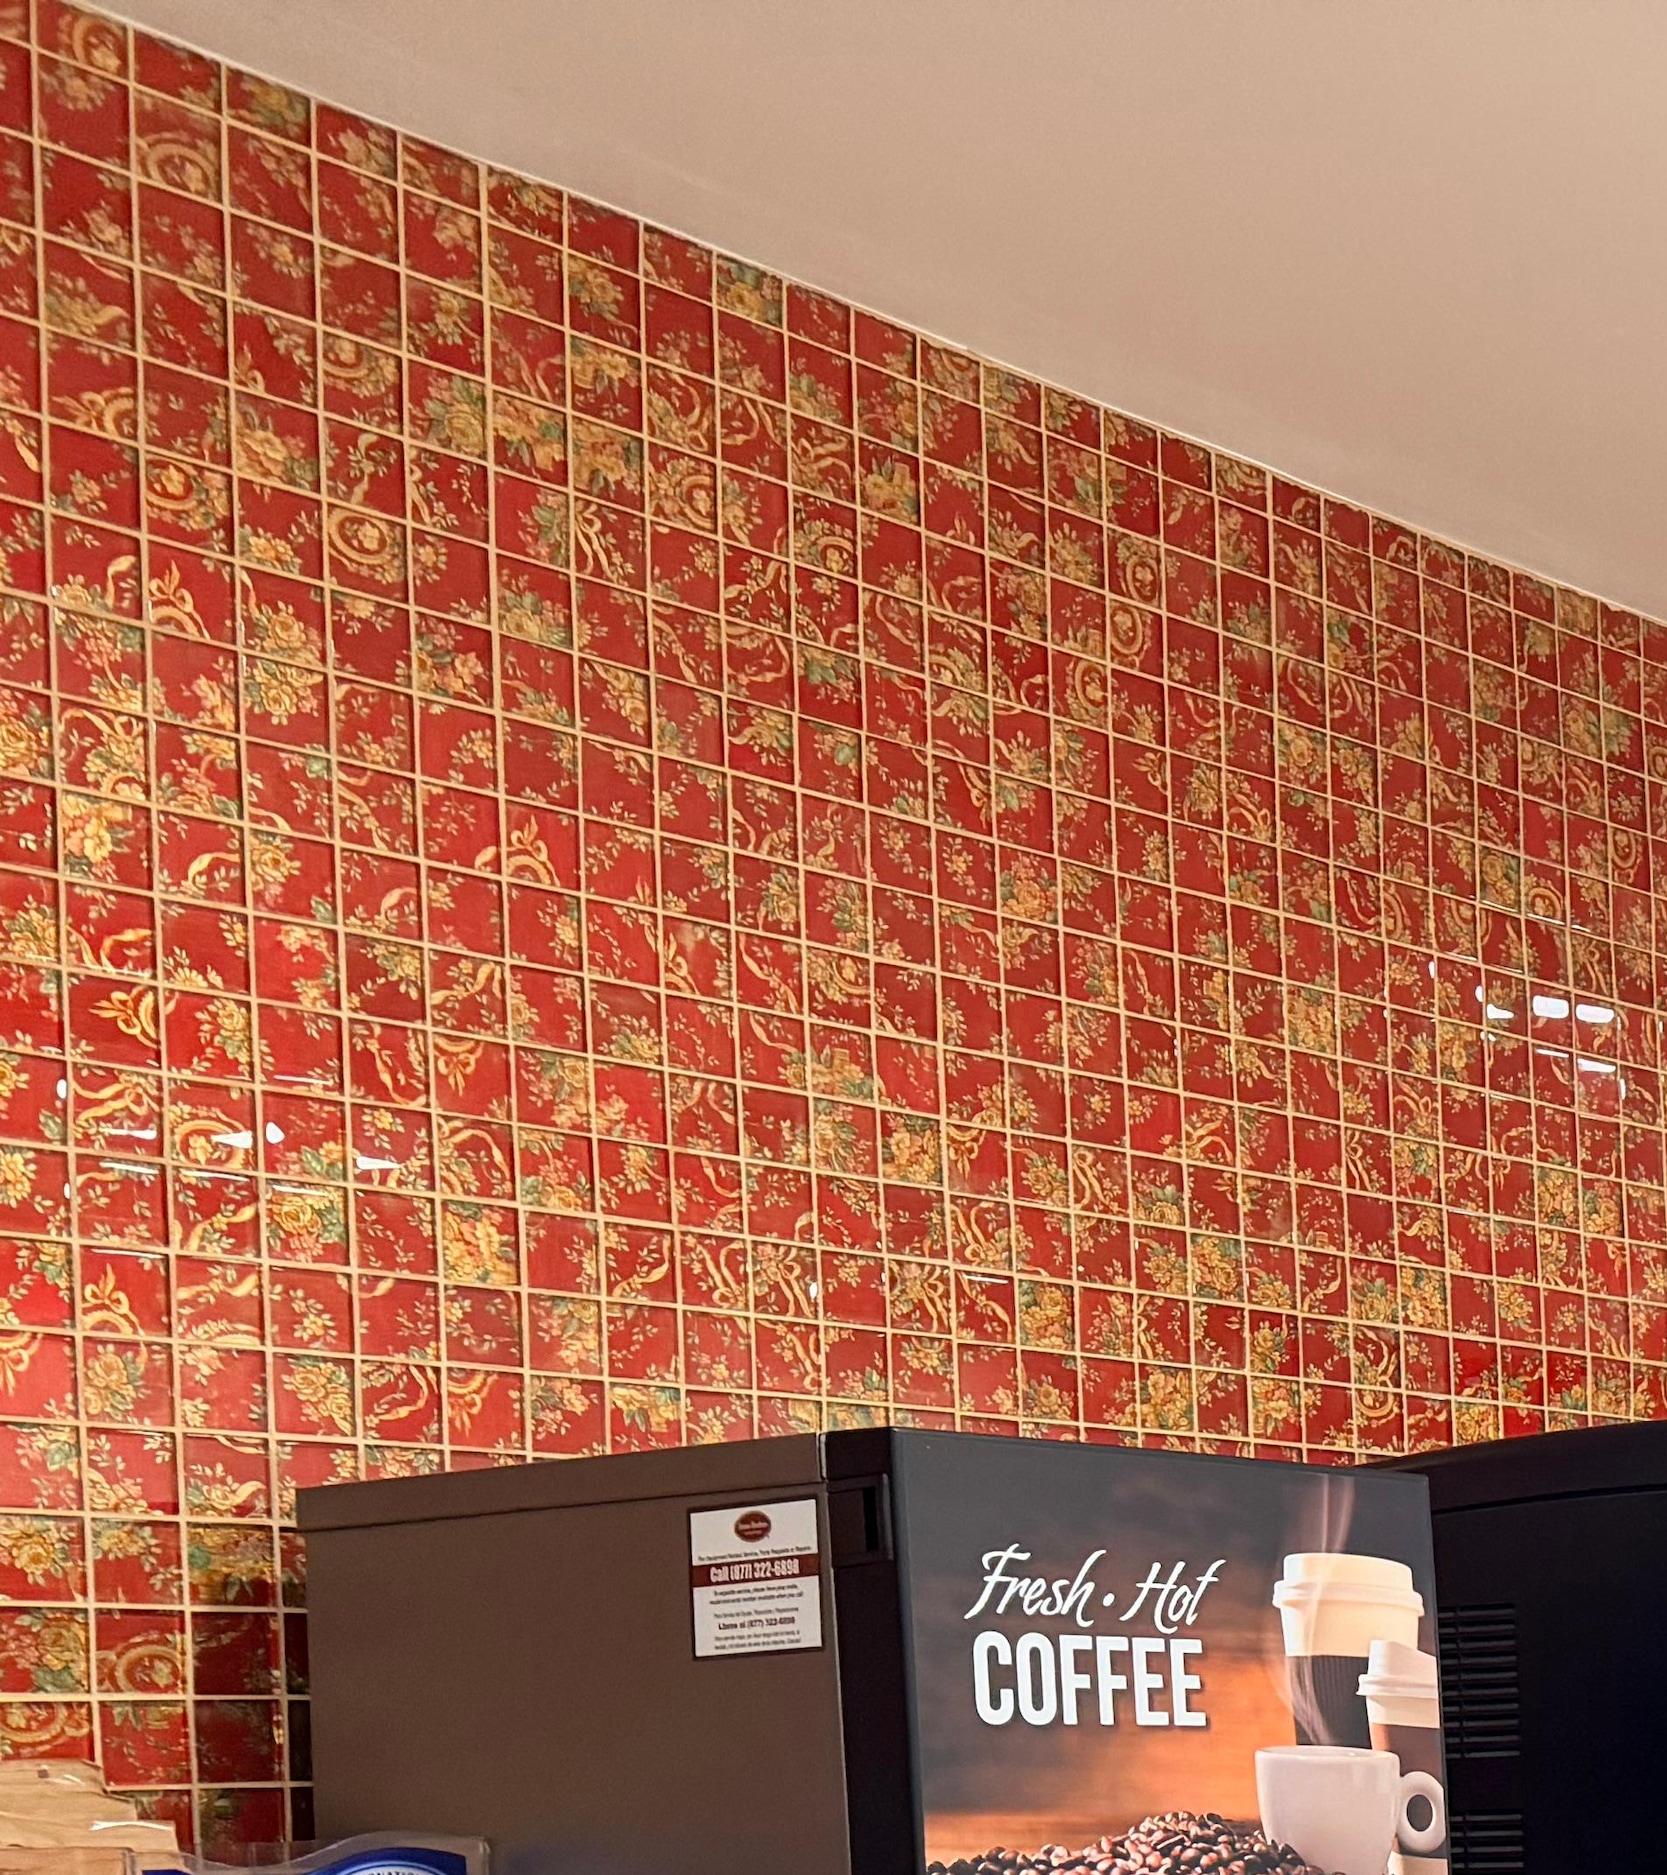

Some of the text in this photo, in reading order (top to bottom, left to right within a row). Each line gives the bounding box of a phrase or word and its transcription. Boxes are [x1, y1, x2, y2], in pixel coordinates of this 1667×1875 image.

[710, 1566, 729, 1583] Call
[963, 1542, 1226, 1634] Fresh Hot
[972, 1630, 1207, 1726] COFFEE
